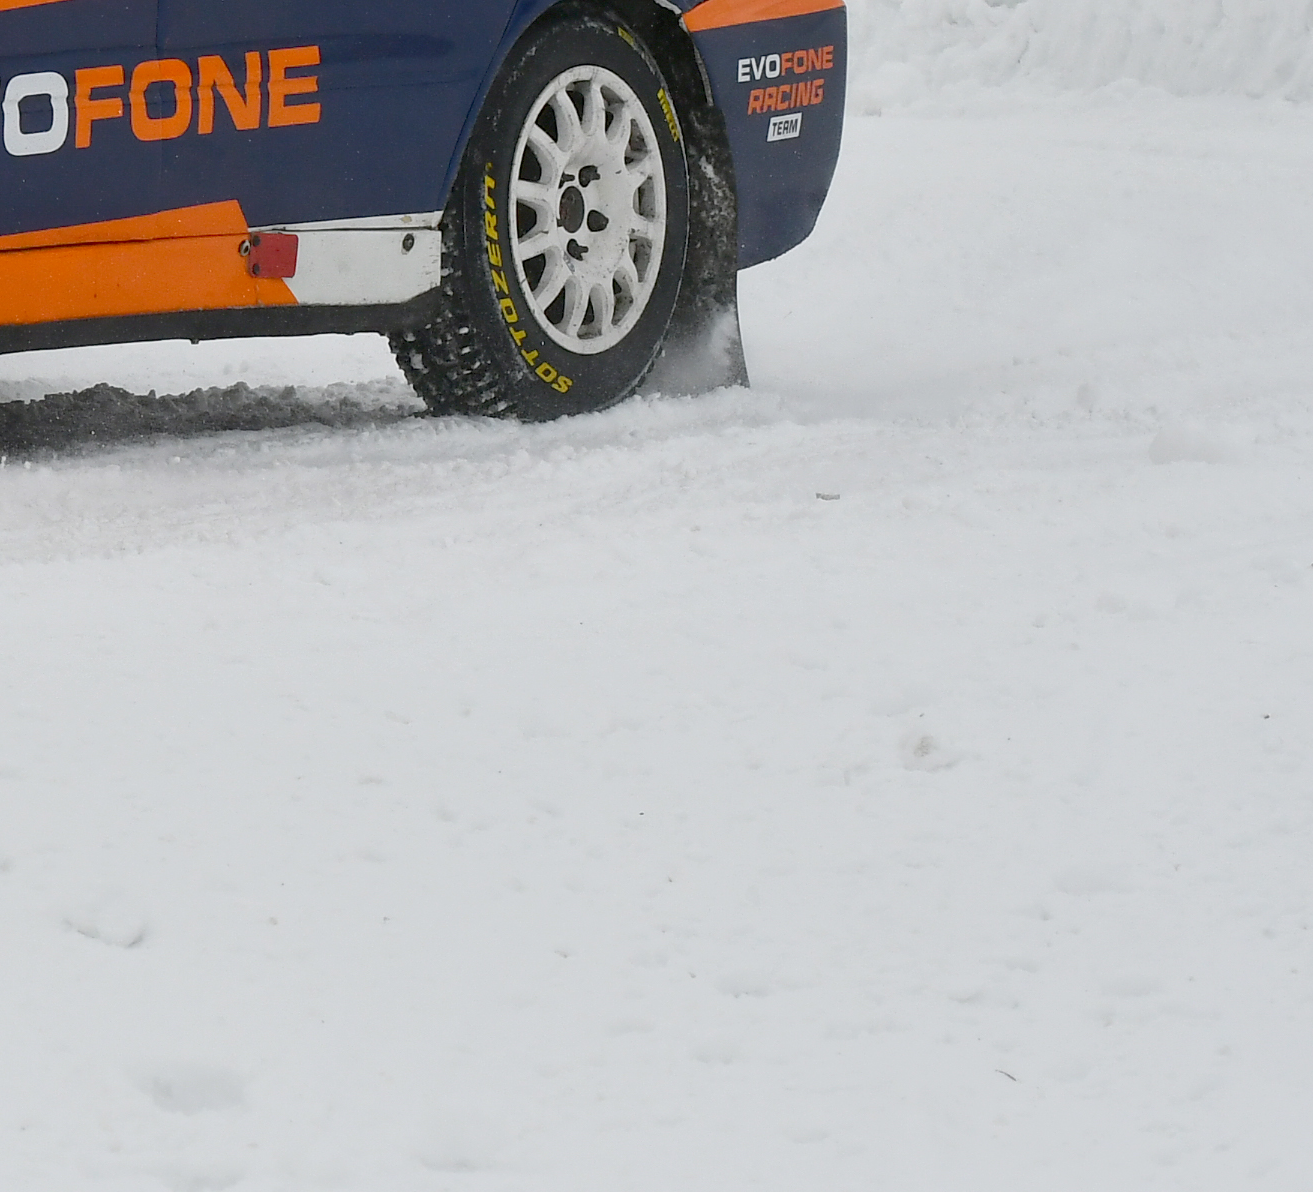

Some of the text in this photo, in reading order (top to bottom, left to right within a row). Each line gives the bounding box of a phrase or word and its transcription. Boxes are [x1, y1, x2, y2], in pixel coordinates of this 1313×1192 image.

[737, 44, 835, 83] EVOFONE
[747, 78, 825, 115] RACING
[770, 117, 800, 138] TEAM
